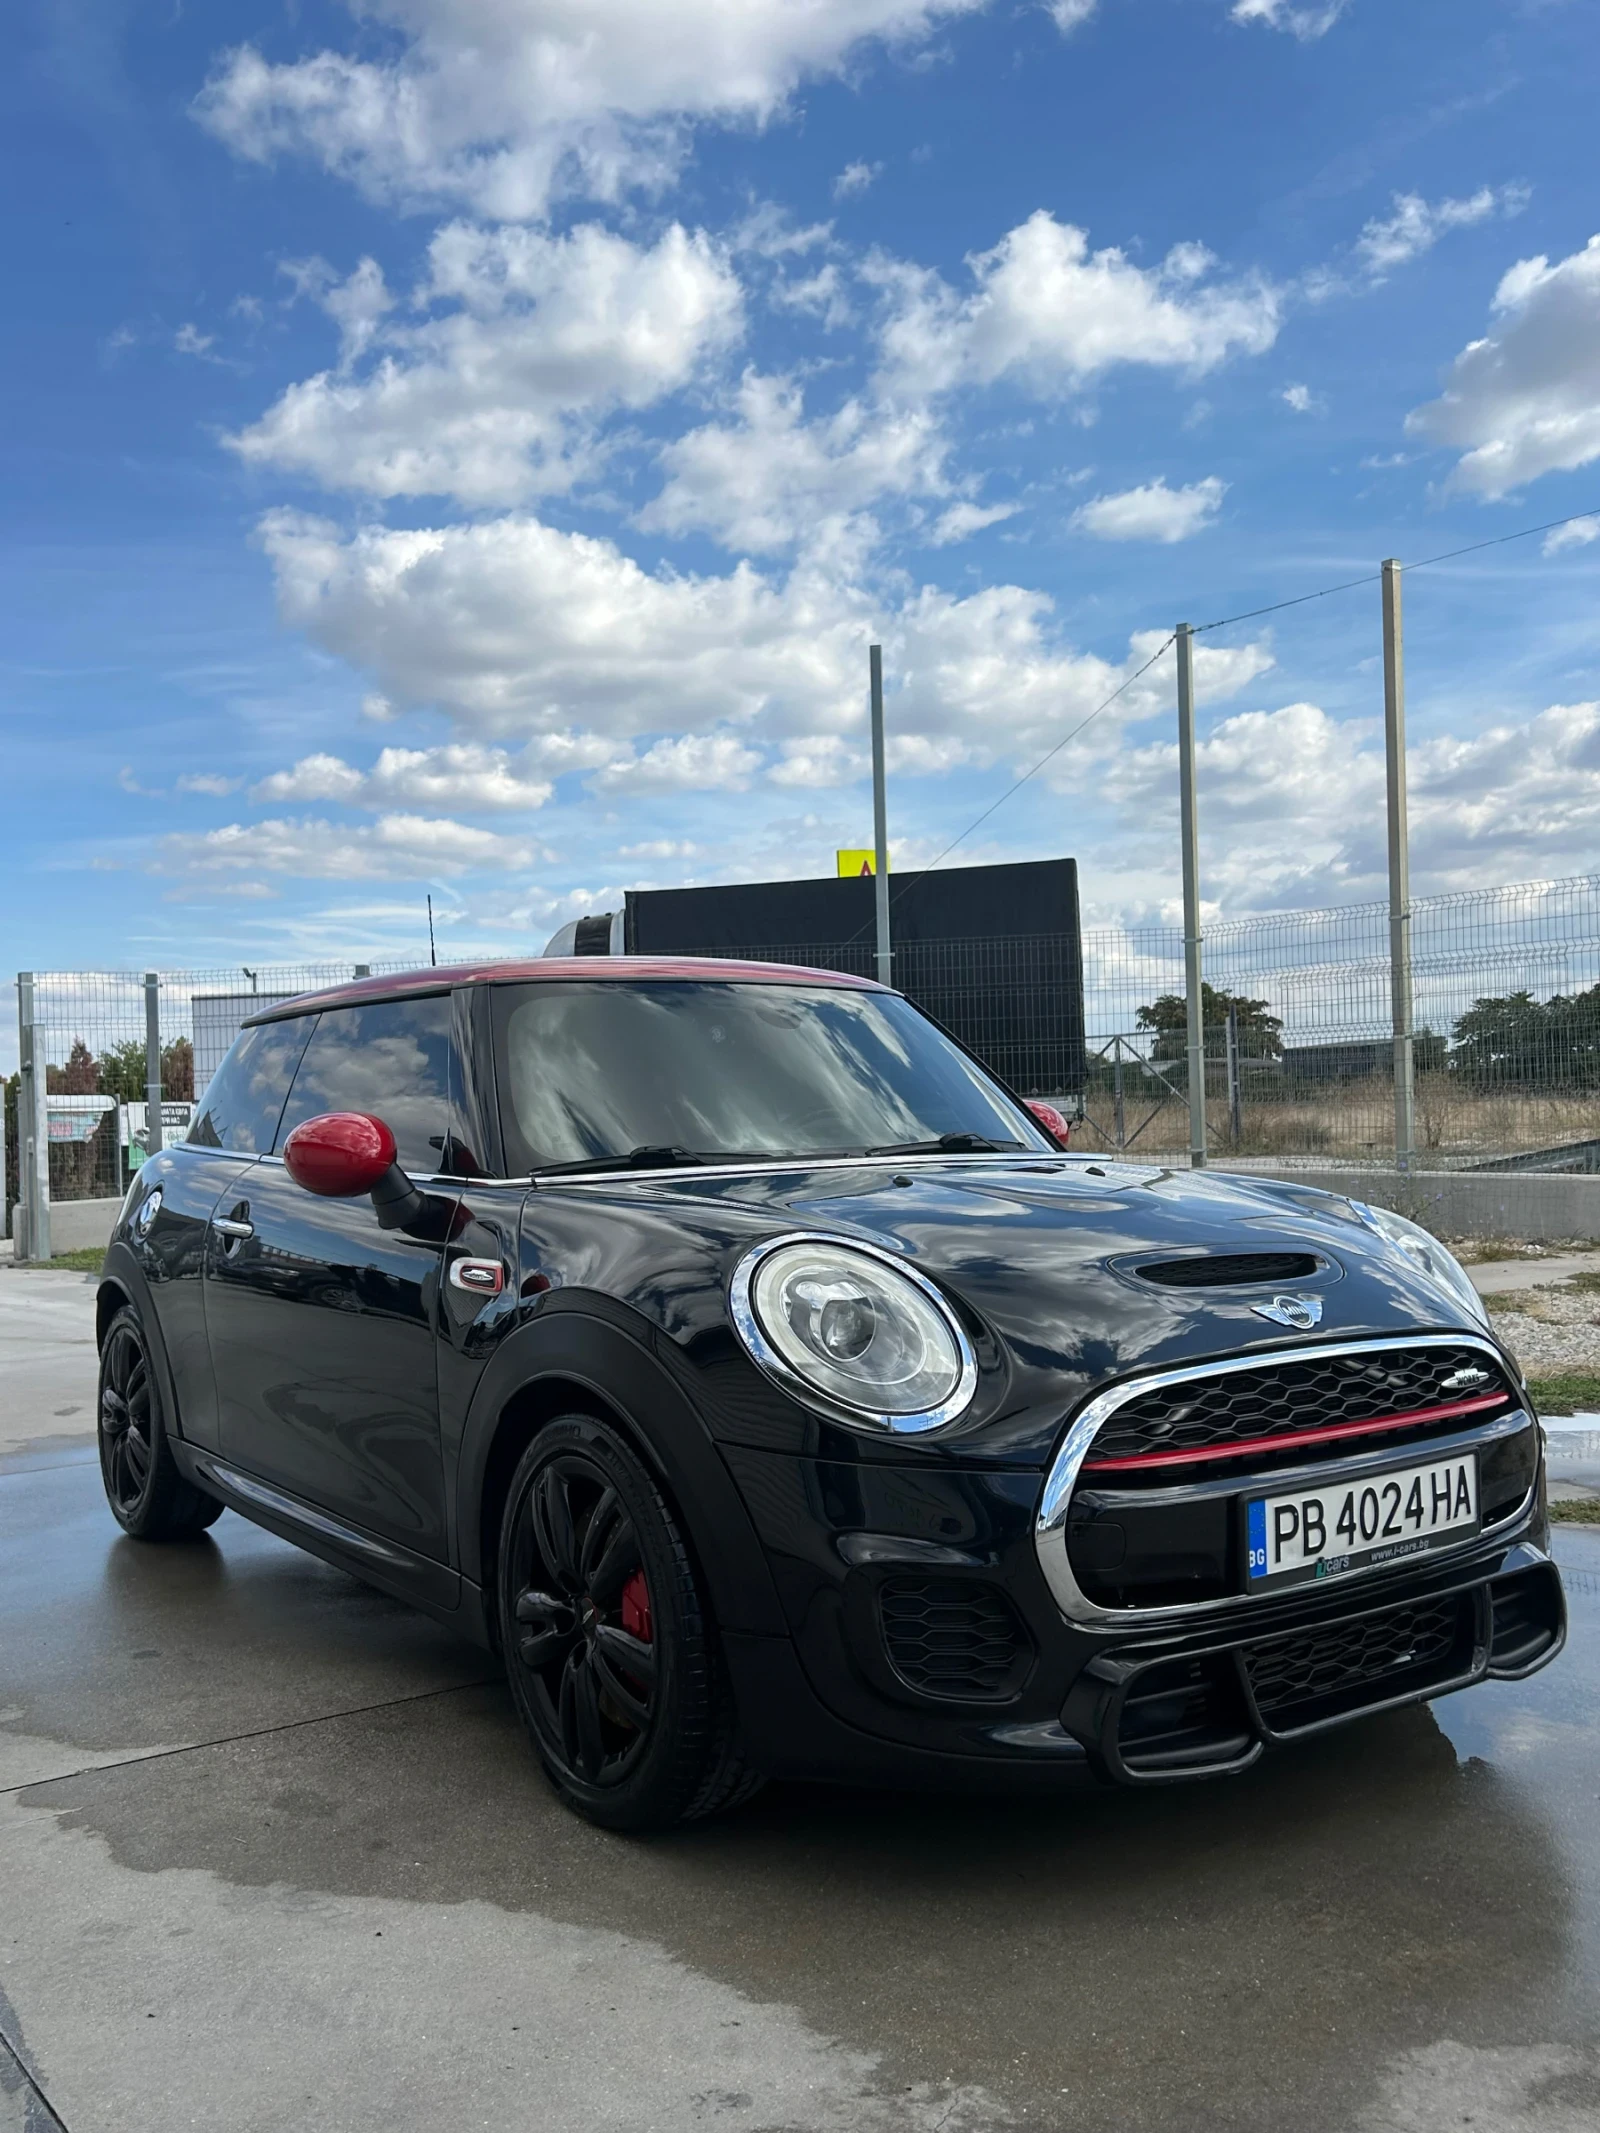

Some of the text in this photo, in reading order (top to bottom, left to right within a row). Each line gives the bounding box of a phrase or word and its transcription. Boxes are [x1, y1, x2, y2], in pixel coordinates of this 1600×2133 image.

[1274, 1465, 1471, 1564] PB 4024 HA
[1249, 1547, 1265, 1568] BG
[1371, 1538, 1429, 1562] www.i-cars.bg
